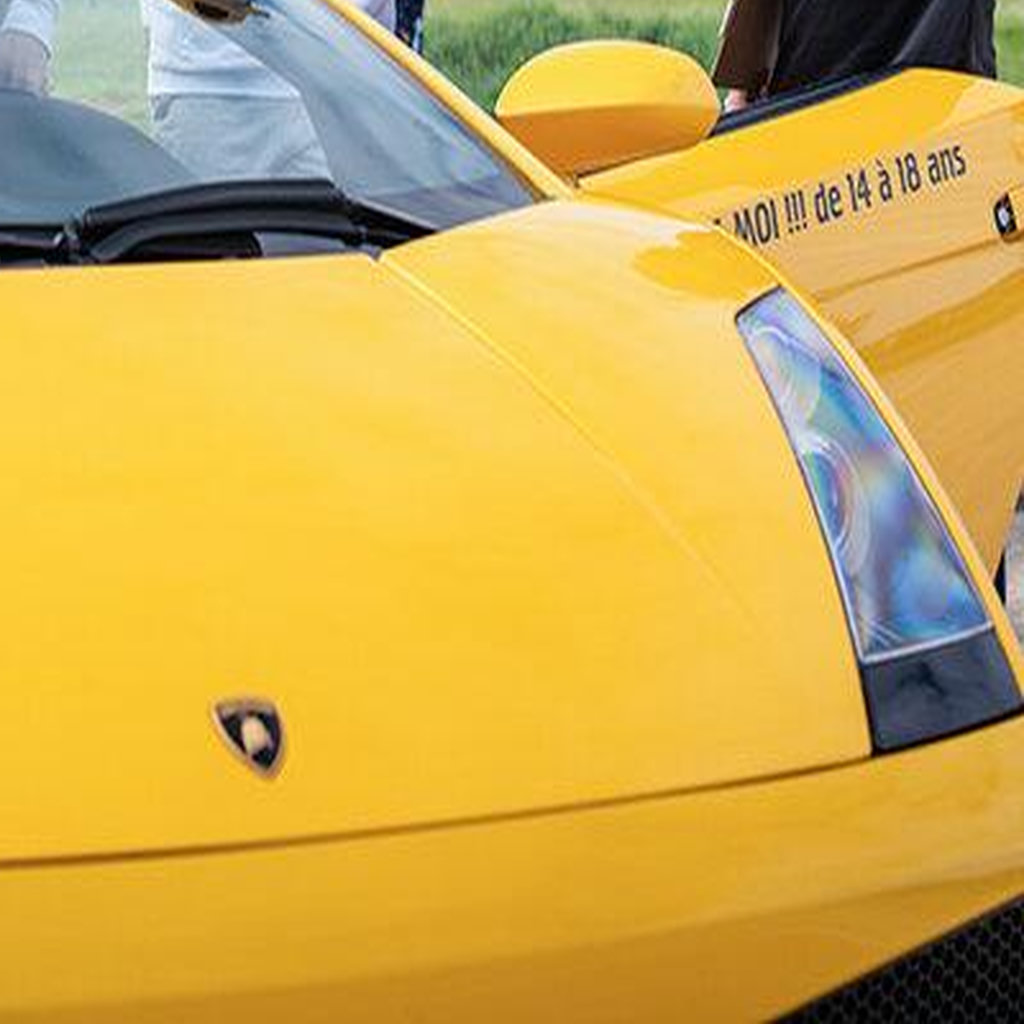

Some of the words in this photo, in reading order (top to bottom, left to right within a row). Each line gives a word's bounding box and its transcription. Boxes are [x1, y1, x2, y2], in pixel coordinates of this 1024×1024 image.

[733, 198, 780, 246] MOI
[784, 189, 808, 234] !!!
[814, 181, 843, 224] de
[846, 169, 872, 212] 14
[875, 157, 893, 202] à
[895, 152, 921, 193] 18
[927, 145, 966, 186] ans
